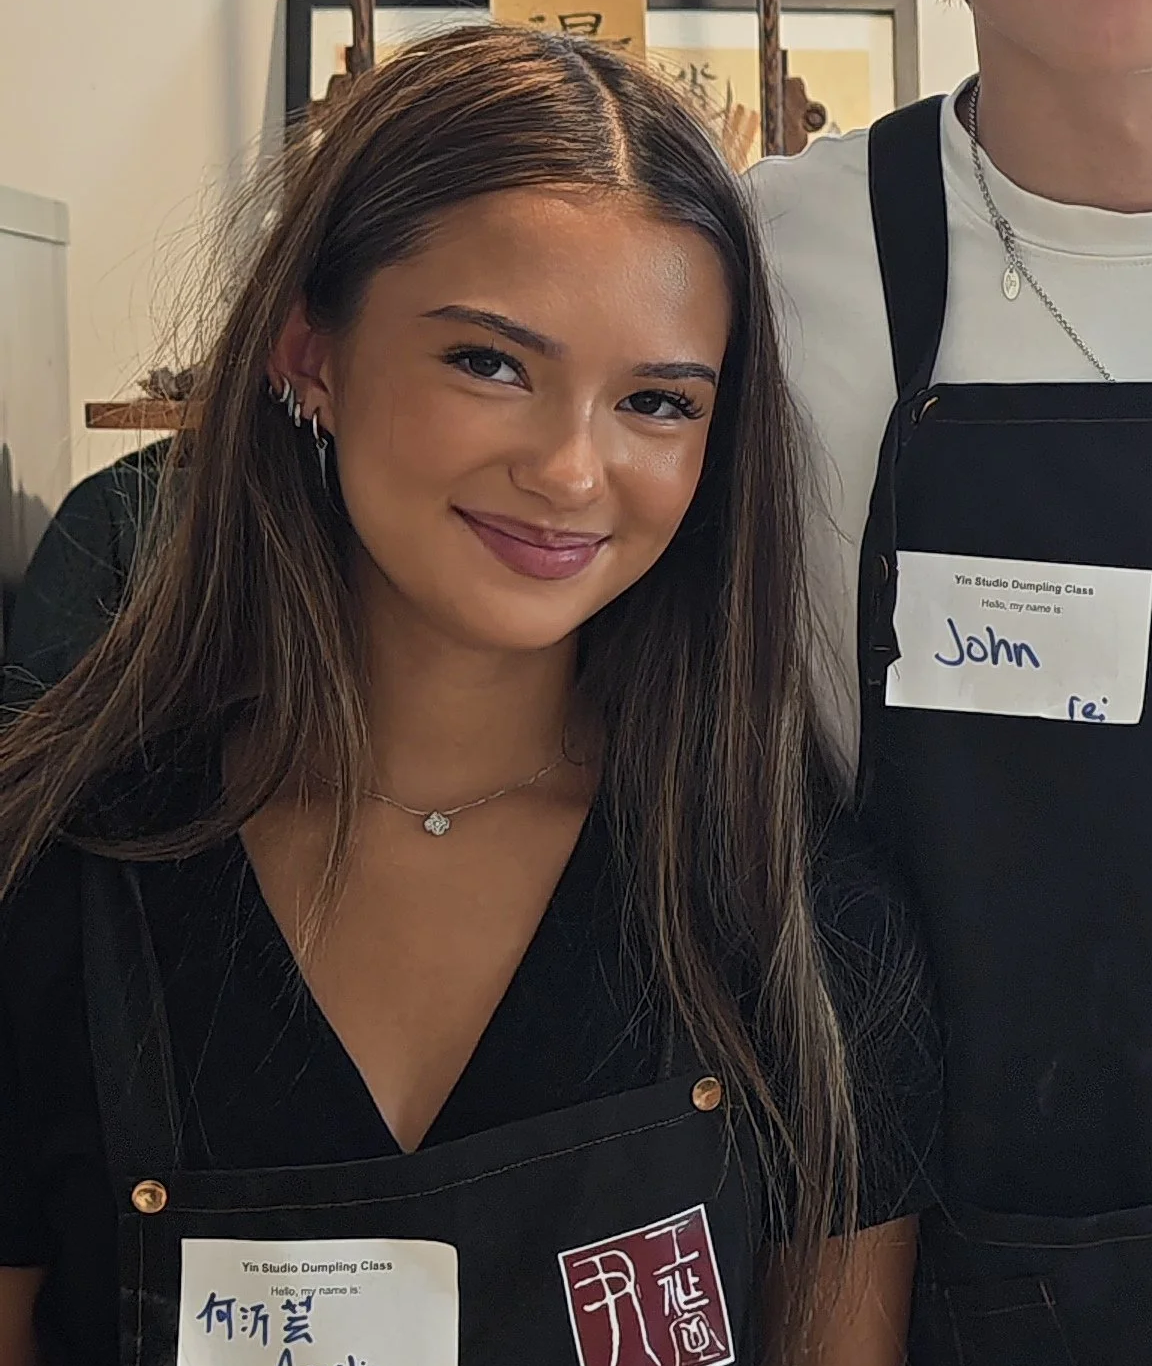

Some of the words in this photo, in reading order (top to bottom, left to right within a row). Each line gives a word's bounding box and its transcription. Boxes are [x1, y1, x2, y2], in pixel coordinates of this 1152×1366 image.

[954, 574, 972, 586] Yin
[975, 576, 1009, 590] Studio
[1011, 579, 1062, 595] Dumpling
[1065, 584, 1094, 596] Class
[981, 598, 1007, 611] Hello,
[1009, 602, 1024, 613] my
[1025, 604, 1051, 613] name
[935, 618, 1040, 668] John
[241, 1261, 260, 1274] Yin
[262, 1262, 298, 1274] Studio
[301, 1261, 357, 1274] Dumpling
[360, 1260, 393, 1272] Class
[270, 1286, 298, 1298] Hello,
[301, 1287, 316, 1299] my
[319, 1287, 347, 1296] name
